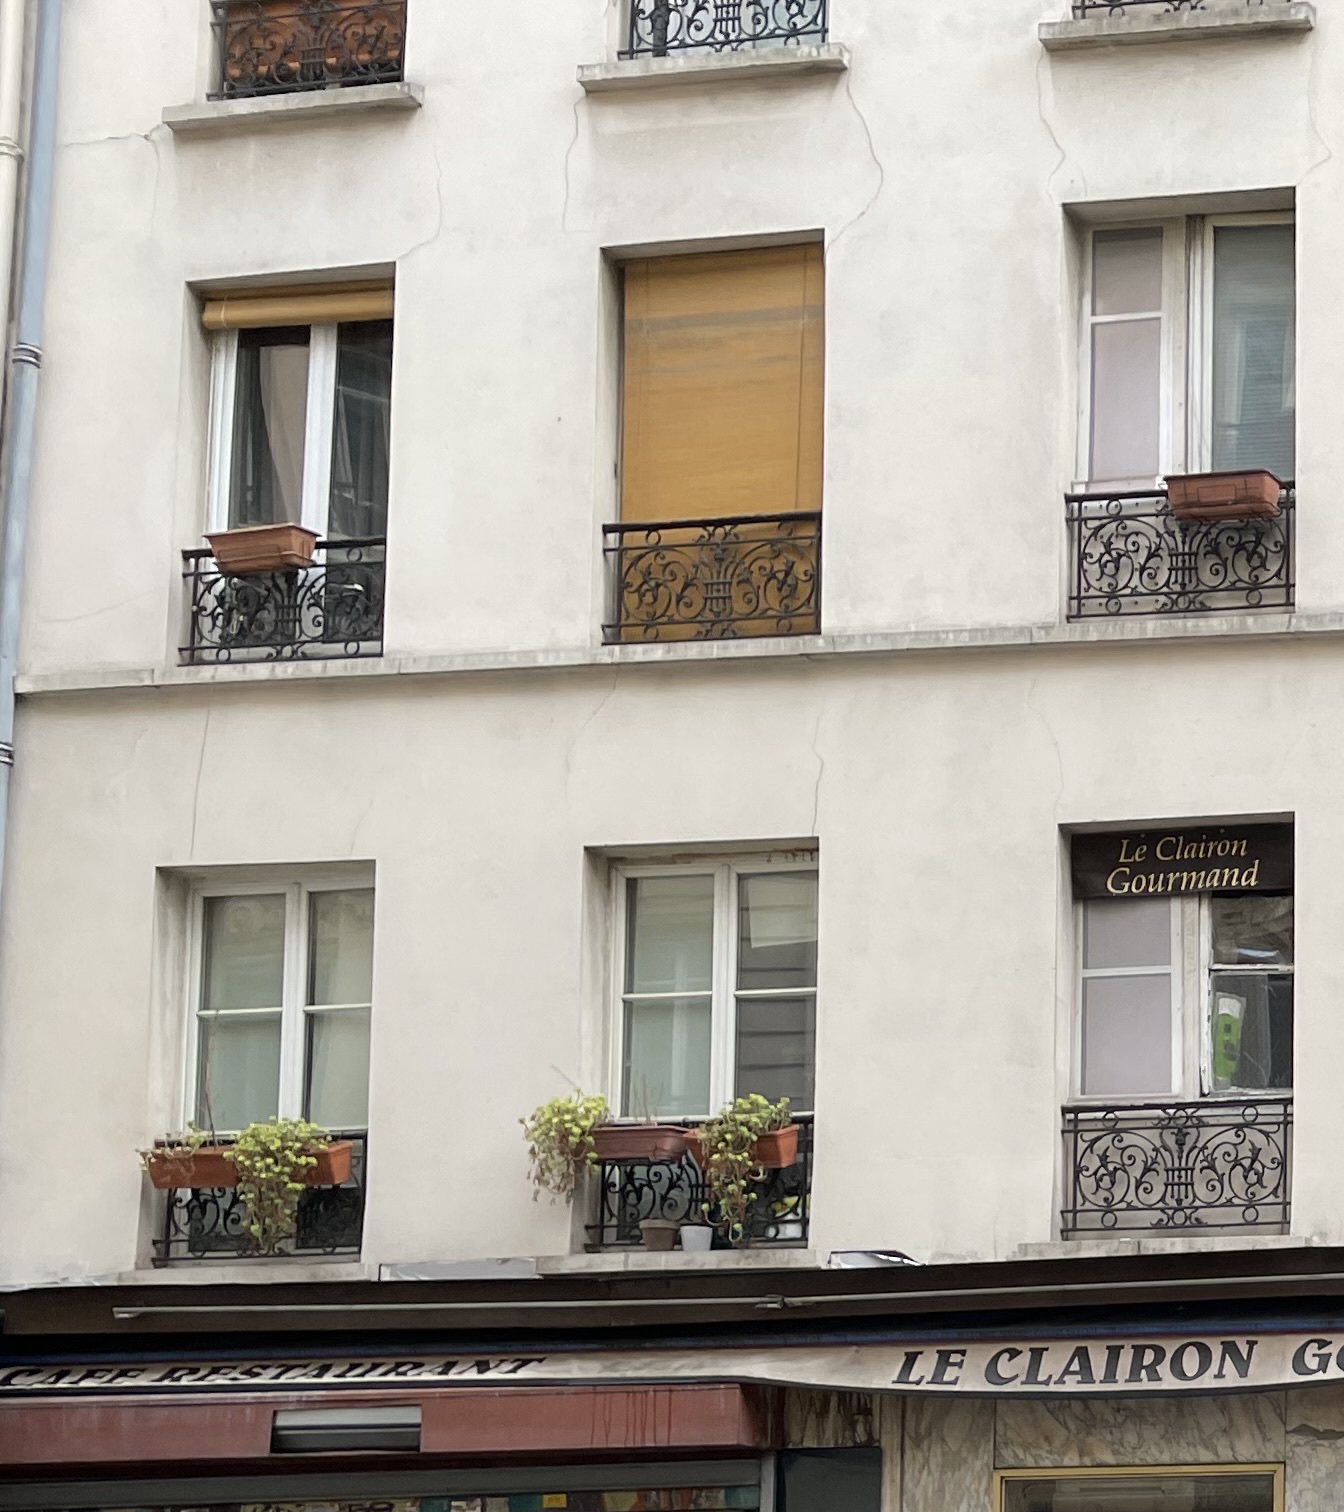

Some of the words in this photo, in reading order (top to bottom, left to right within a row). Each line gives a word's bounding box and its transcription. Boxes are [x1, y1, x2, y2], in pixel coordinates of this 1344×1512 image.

[1118, 839, 1147, 863] Le
[1156, 835, 1248, 861] Clairon
[1106, 859, 1260, 894] Gourmand
[150, 1356, 547, 1383] RESTAURANT
[891, 1348, 967, 1386] LE
[985, 1339, 1259, 1386] CLAIRON
